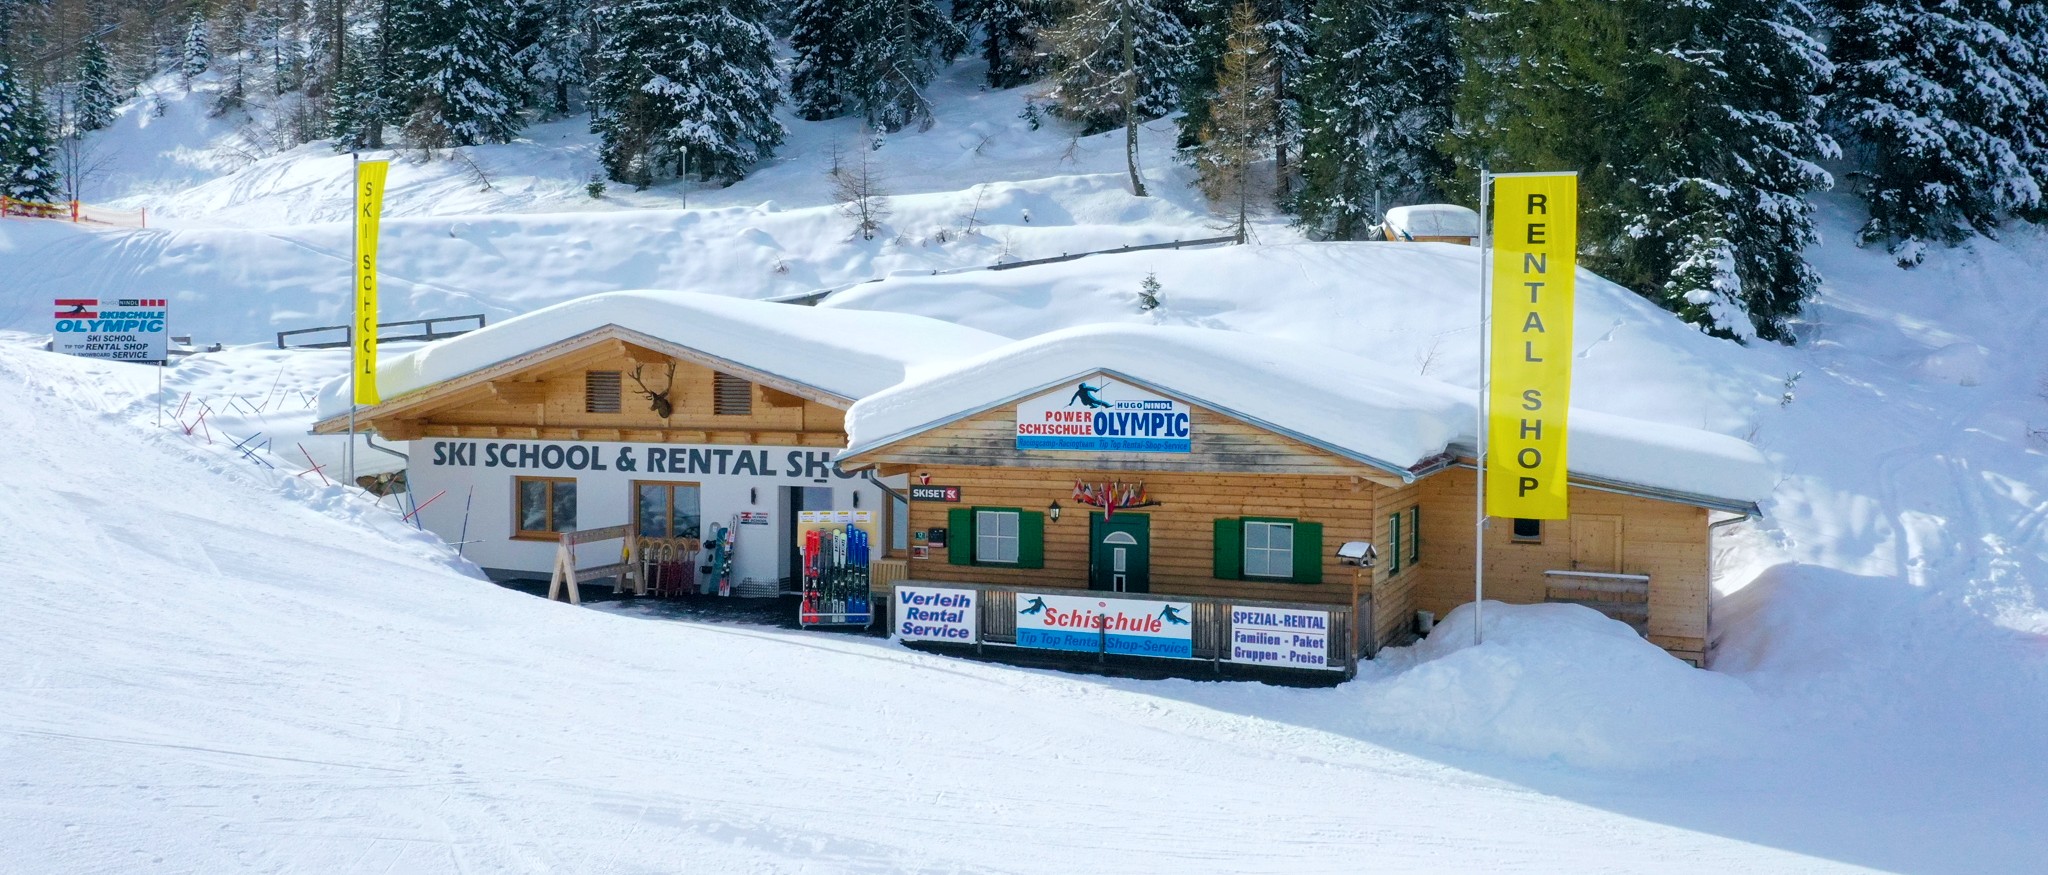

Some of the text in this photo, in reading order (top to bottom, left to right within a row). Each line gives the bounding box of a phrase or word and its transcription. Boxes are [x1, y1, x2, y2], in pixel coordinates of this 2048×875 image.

[363, 181, 373, 238] SKI
[99, 311, 165, 319] SKISCHULE
[55, 320, 164, 333] OLYMPIC
[86, 334, 137, 342] SKI SCHOOL
[1517, 193, 1548, 498] RENTAL SHOP
[85, 343, 121, 351] RENTAL
[123, 343, 149, 351] SHOP
[112, 351, 148, 359] SERVICE
[1144, 401, 1172, 410] NINDL
[1045, 411, 1092, 423] POWER
[1093, 411, 1189, 437] OLYMPIC
[1018, 423, 1092, 436] SCHISCHULE
[433, 441, 868, 479] SKI SCHOOL & RENTAL SH
[912, 488, 946, 498] SKISET
[900, 591, 971, 608] Verleih
[906, 607, 964, 623] Rental
[1043, 607, 1163, 633] Schischule
[1233, 611, 1326, 630] SPEZIAL-RENTAL
[901, 622, 969, 639] Service
[1020, 631, 1189, 654] Tip Top Renta-Shop-Service
[1234, 631, 1280, 645] Familien
[1292, 634, 1324, 649] Paket
[1234, 646, 1278, 662] Gruppen
[1289, 650, 1324, 664] Preise
